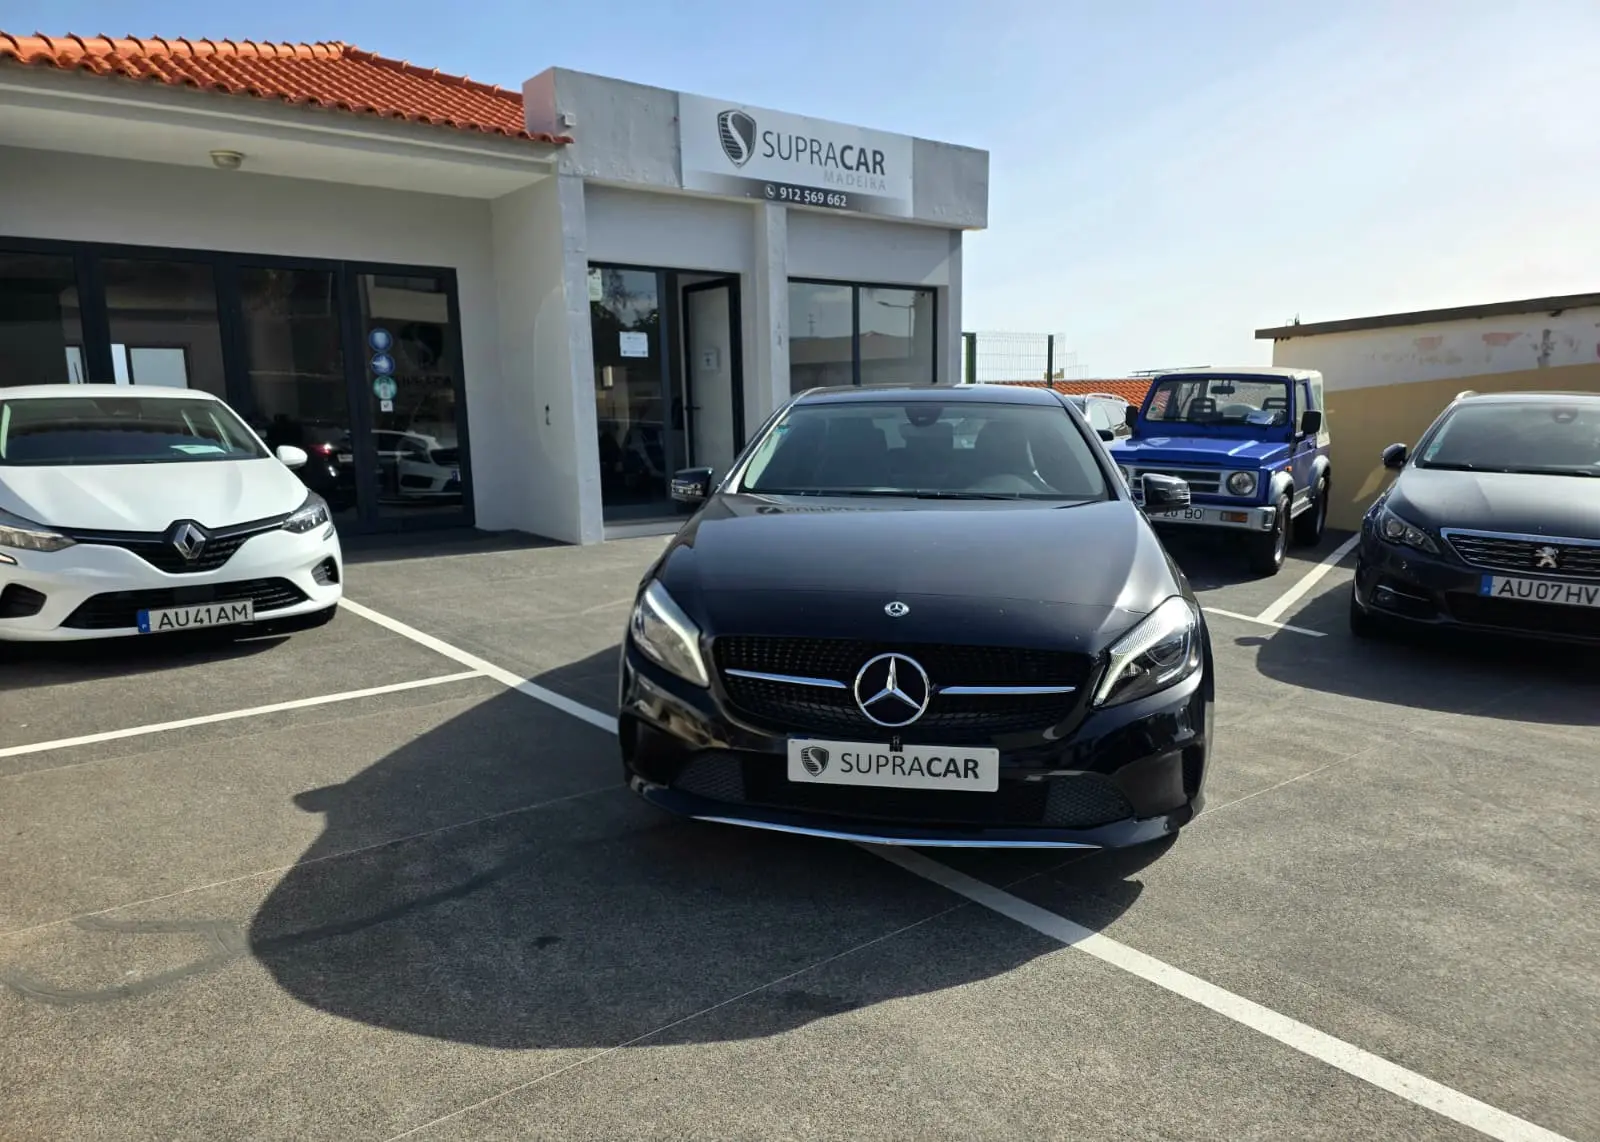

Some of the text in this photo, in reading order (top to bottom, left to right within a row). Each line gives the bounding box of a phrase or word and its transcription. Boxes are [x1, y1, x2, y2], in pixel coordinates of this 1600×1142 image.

[762, 130, 886, 176] SUPRACAR
[823, 169, 887, 192] MADEIRA
[780, 186, 847, 207] 912 569 662
[840, 752, 980, 780] SUPRACAR
